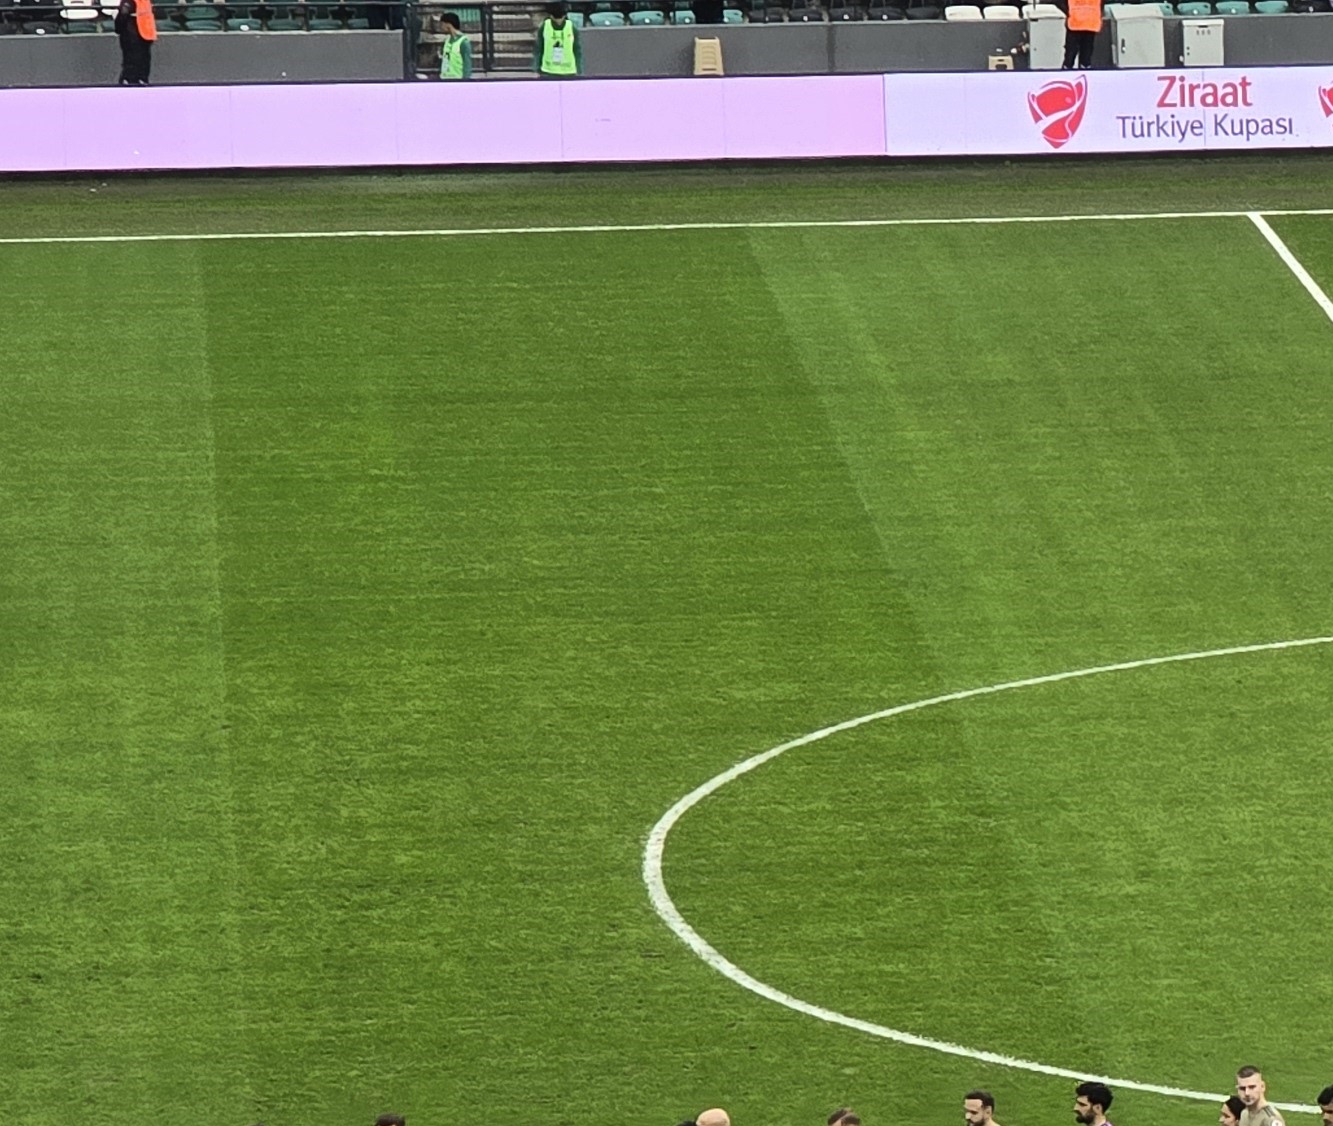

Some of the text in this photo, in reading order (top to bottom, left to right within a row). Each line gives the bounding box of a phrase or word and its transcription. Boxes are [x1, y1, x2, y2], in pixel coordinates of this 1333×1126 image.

[1156, 75, 1252, 108] Ziraat
[1116, 113, 1294, 144] Türkiye Kupası
